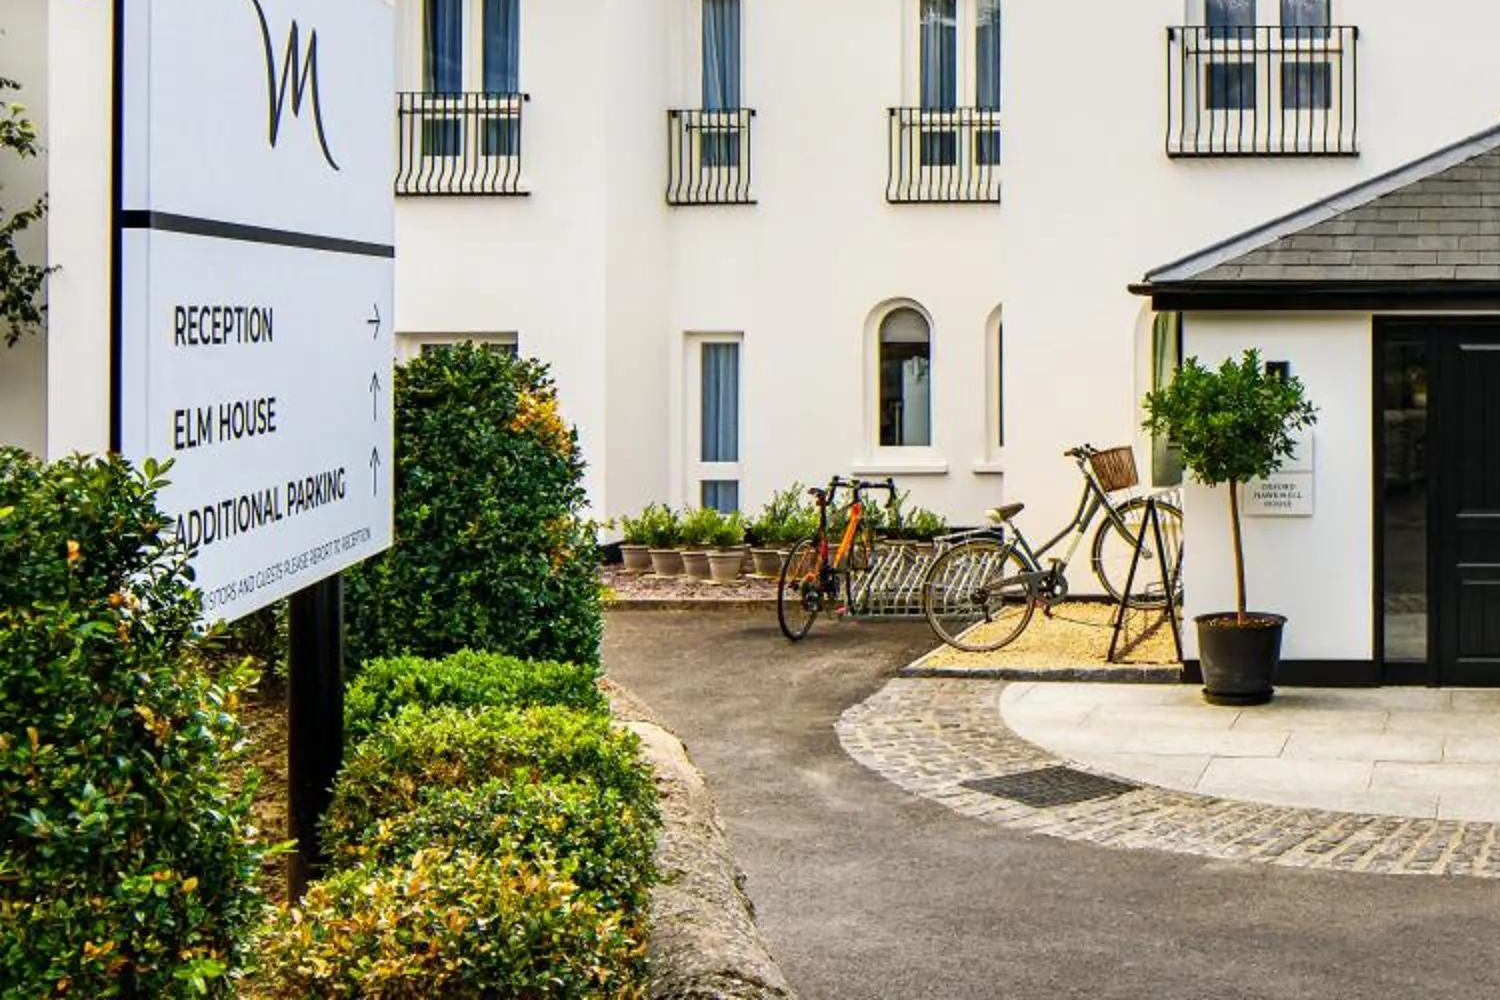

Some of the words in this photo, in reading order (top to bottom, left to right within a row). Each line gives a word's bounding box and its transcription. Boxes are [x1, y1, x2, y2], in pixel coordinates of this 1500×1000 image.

[175, 305, 273, 346] RECEPTION
[174, 405, 213, 451] ELM
[219, 397, 277, 442] HOUSE
[175, 487, 283, 552] ADDITIONAL
[287, 467, 346, 517] PARKING
[238, 575, 255, 597] AND
[283, 551, 309, 576] PLEASE
